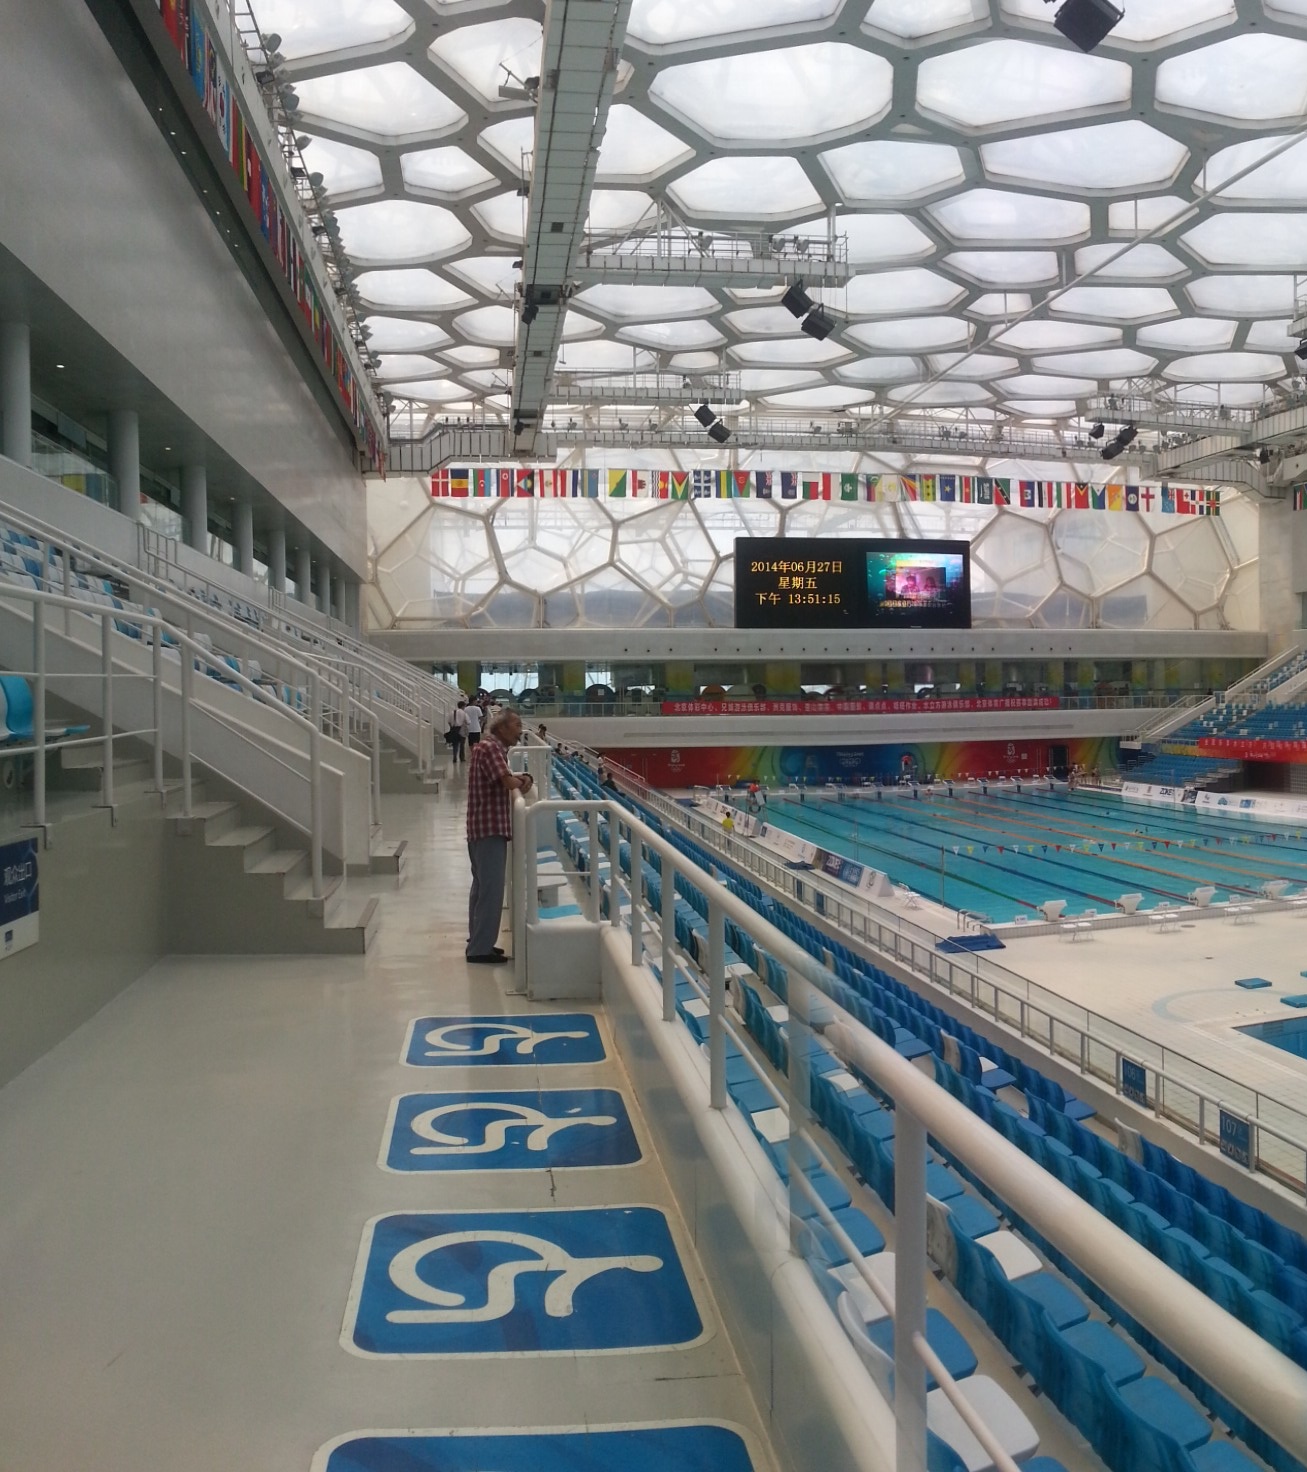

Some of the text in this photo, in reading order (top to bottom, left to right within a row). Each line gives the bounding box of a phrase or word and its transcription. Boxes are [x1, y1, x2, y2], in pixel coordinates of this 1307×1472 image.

[751, 560, 842, 573] 2014年06月27日
[778, 576, 818, 589] 星期五
[755, 592, 841, 605] 下午 13:51:15
[1223, 1116, 1237, 1136] 107
